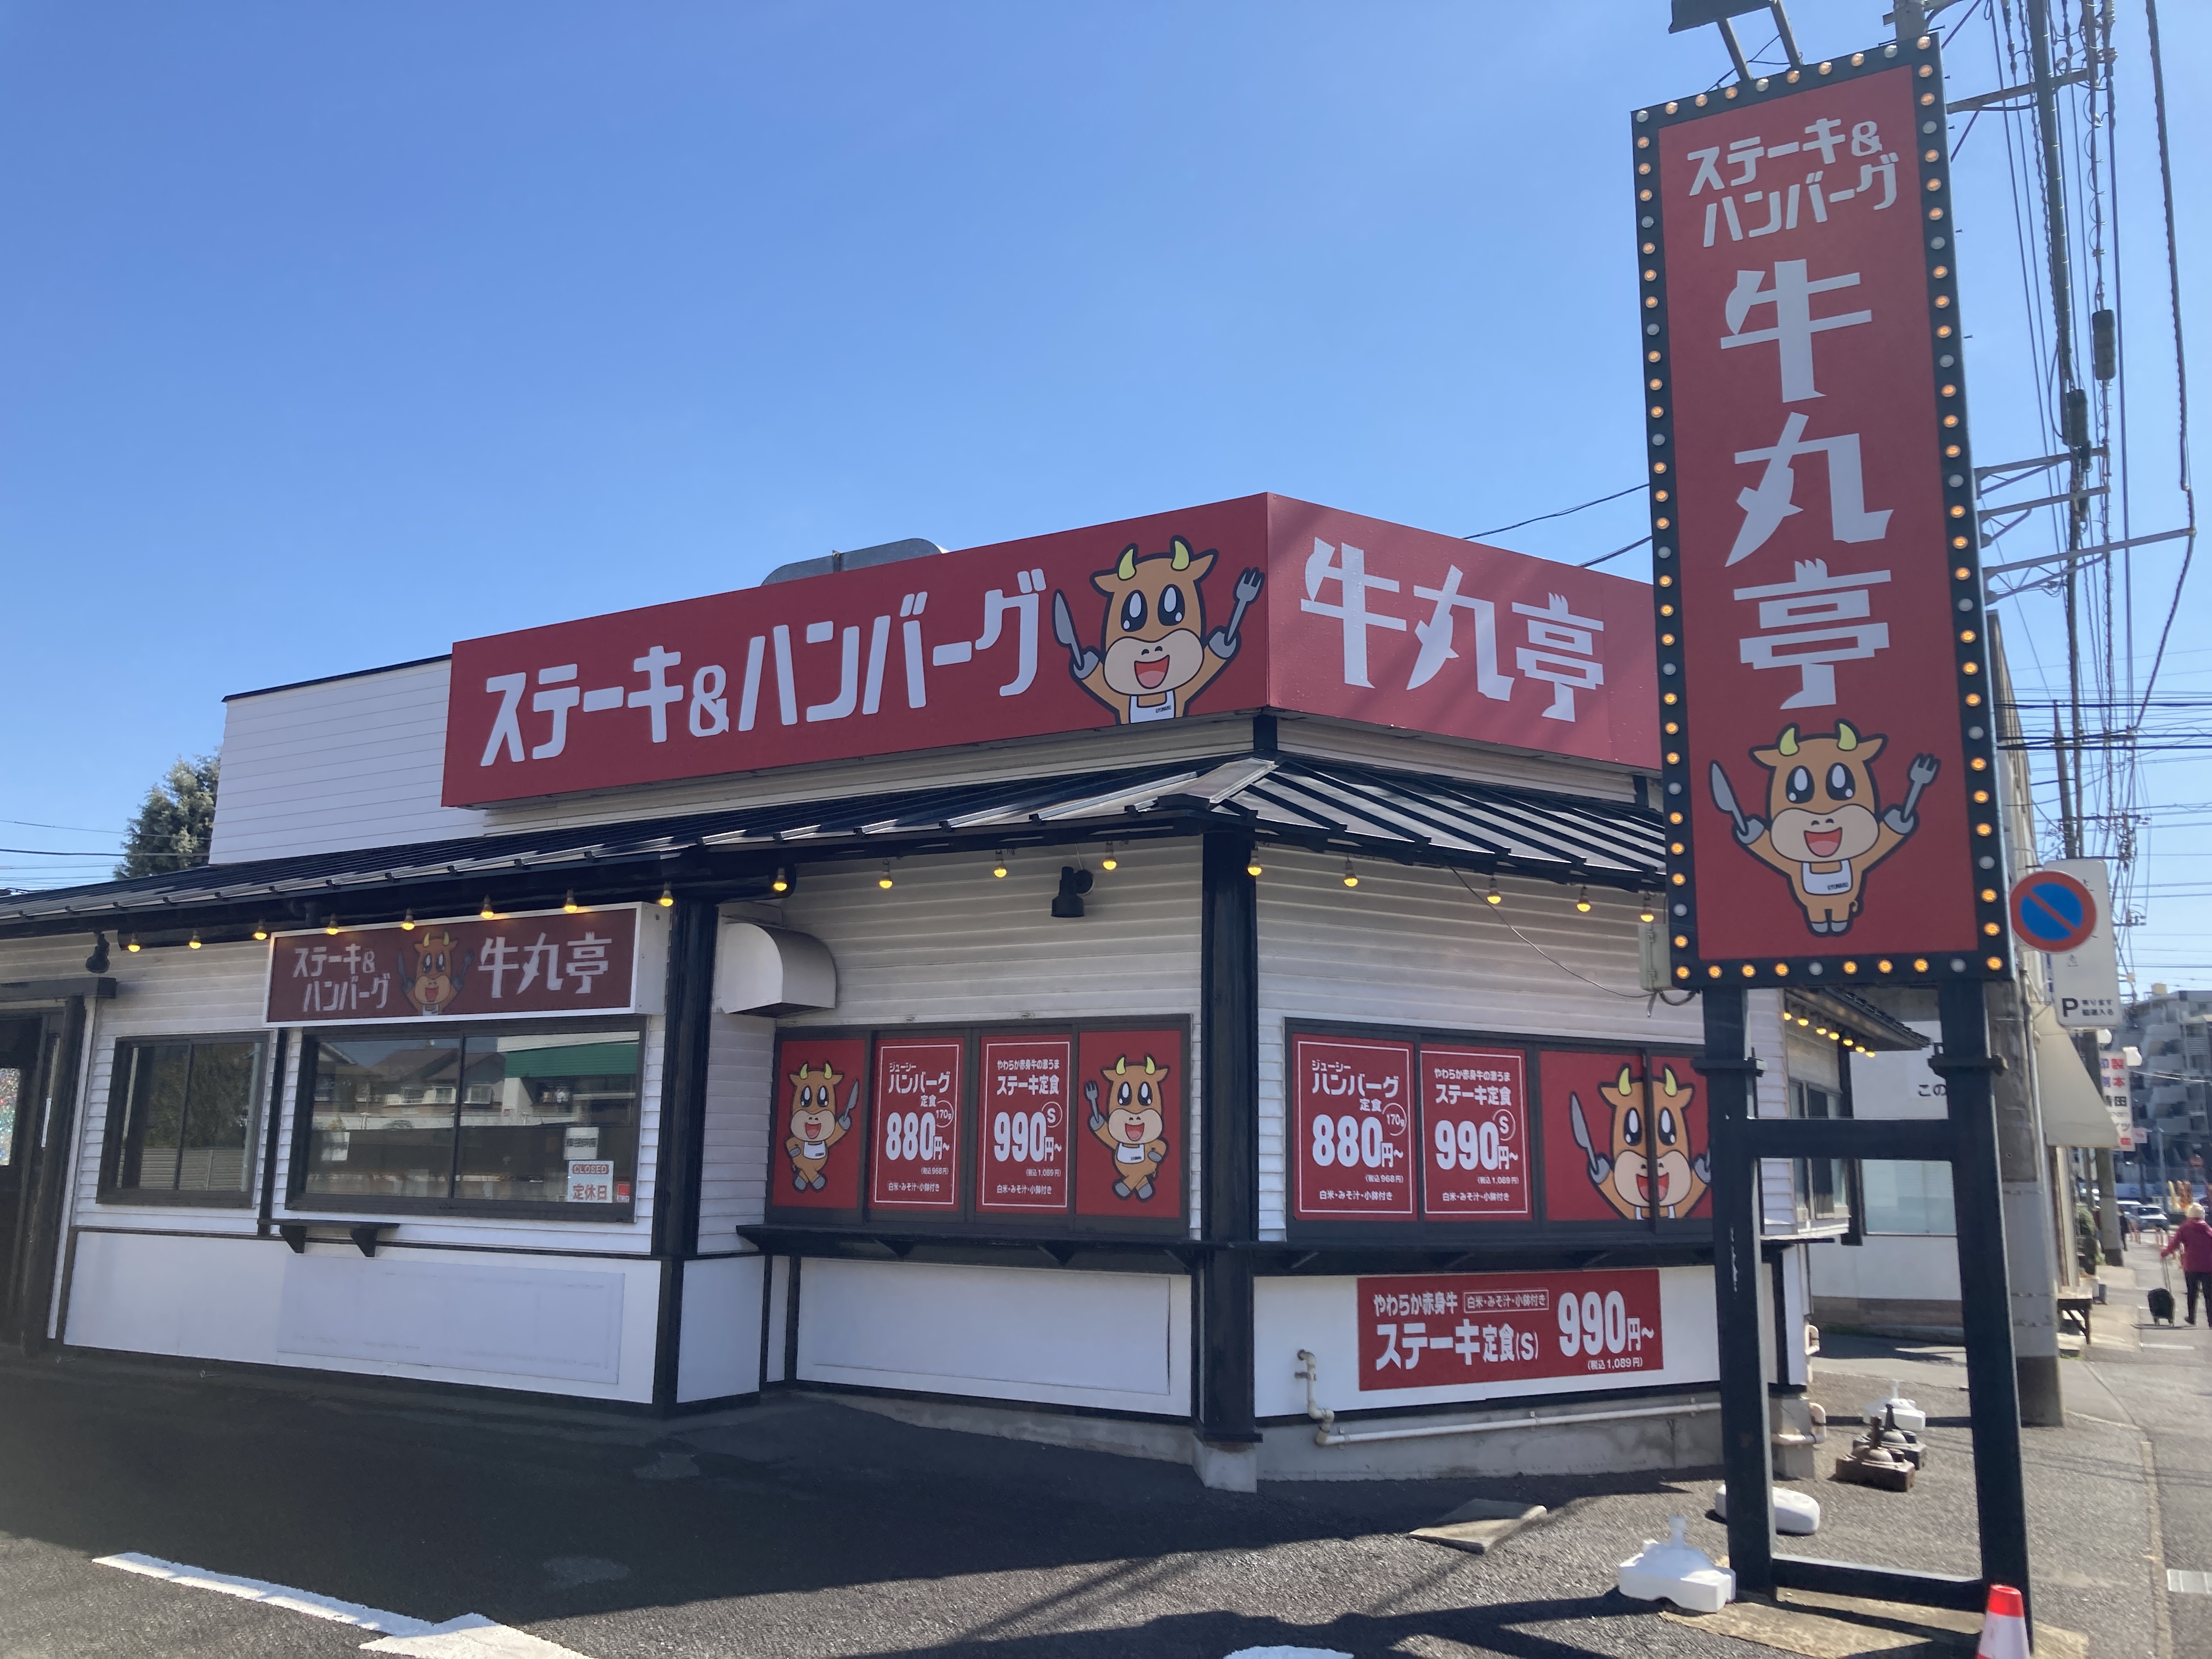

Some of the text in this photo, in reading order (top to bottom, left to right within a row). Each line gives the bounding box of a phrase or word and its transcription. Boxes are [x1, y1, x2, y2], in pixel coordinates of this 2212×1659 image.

[1687, 117, 1883, 196] ステーキ&
[1703, 153, 1899, 248] ハンバーグ
[1720, 258, 1894, 710] 牛丸亭
[1300, 537, 1604, 723] 牛丸亭
[481, 568, 1047, 767] ステーキ&ハンバーグ
[292, 943, 376, 978] ステーキ&
[478, 932, 612, 998] 牛丸亭
[303, 972, 391, 1012] ハンバーグ
[2062, 998, 2079, 1017] P
[889, 1062, 917, 1073] ジューシー
[1312, 1059, 1351, 1073] ジューシー
[888, 1071, 951, 1093] ハンバーグ
[997, 1074, 1059, 1096] ステーキ定食
[1312, 1073, 1400, 1098] ハンバーグ
[920, 1094, 936, 1107] 定食
[1359, 1098, 1382, 1112] 定食
[1435, 1084, 1511, 1107] ステーキ定食
[936, 1109, 952, 1120] 170g
[1047, 1108, 1057, 1124] S
[1386, 1113, 1405, 1127] 170g
[1499, 1115, 1509, 1135] S
[574, 1165, 607, 1173] CLOSED
[572, 1183, 607, 1201] 定休日
[1374, 1291, 1458, 1317] やわらか赤身牛
